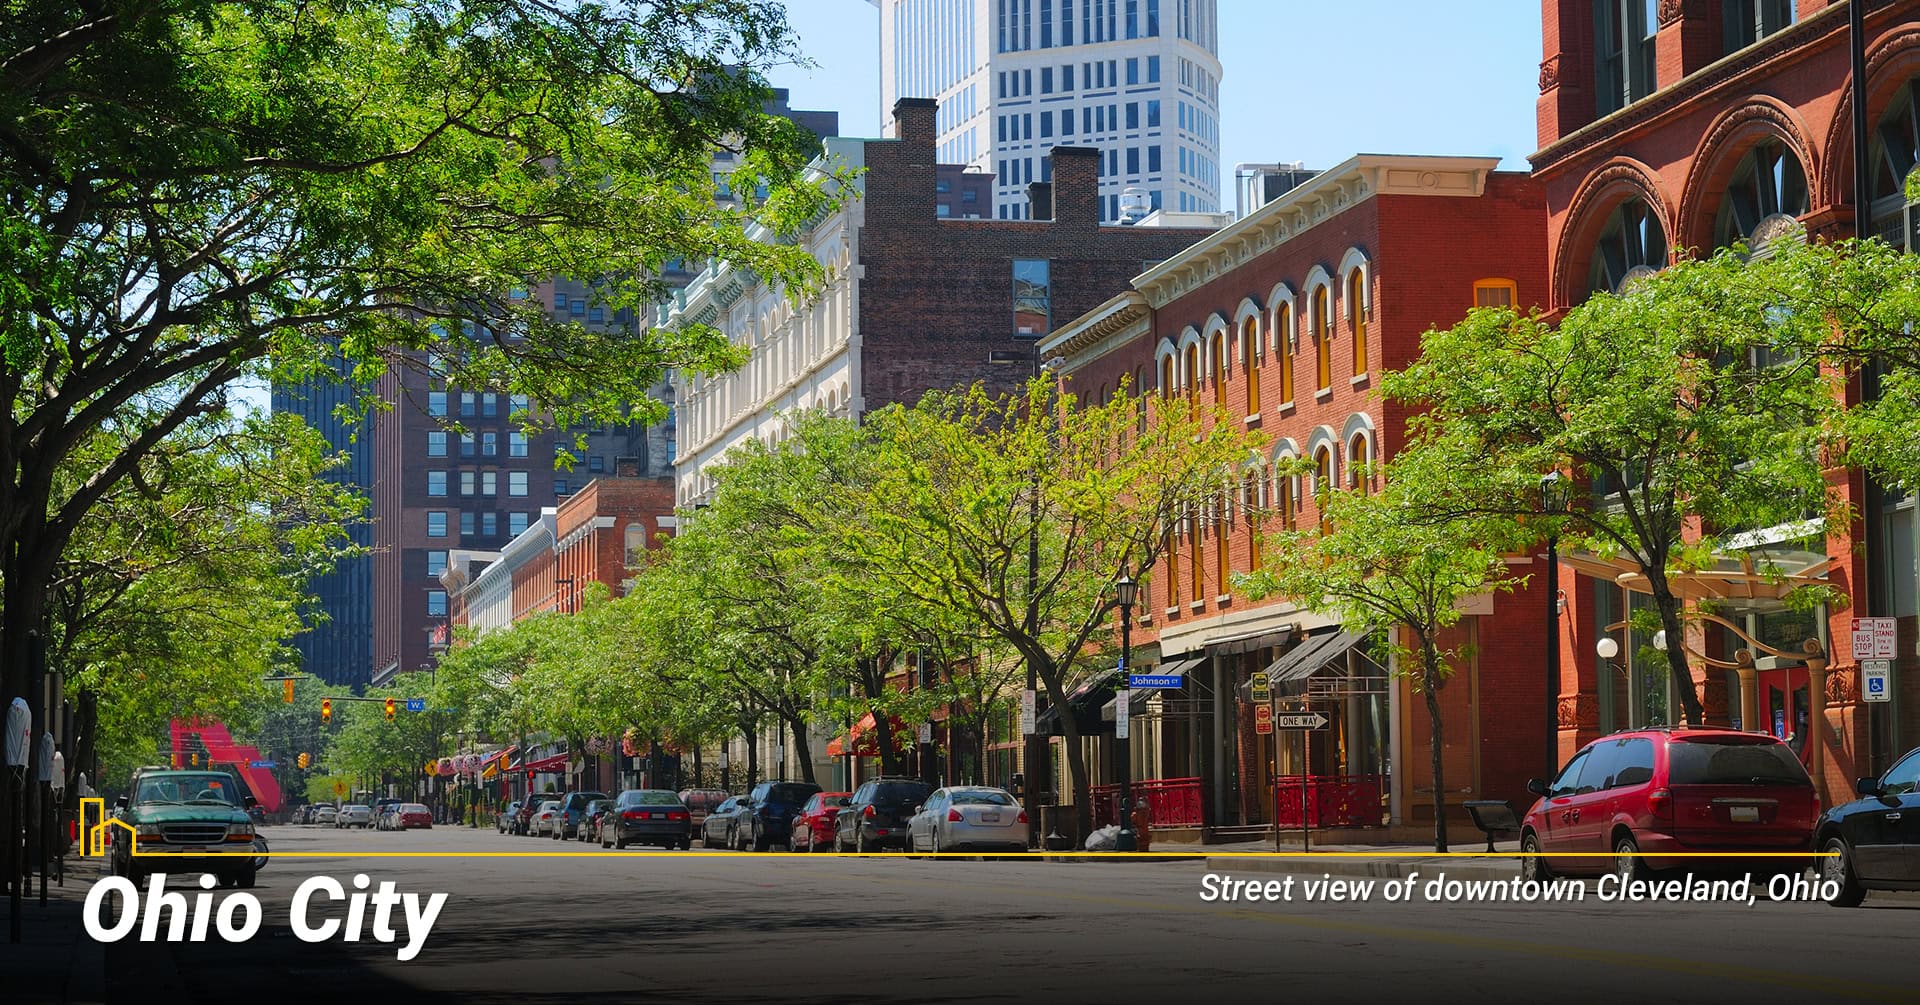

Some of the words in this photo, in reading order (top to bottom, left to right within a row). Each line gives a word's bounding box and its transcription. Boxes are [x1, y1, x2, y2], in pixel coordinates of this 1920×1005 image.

[1131, 676, 1170, 685] Johnson
[1282, 717, 1299, 726] ONE
[1302, 716, 1318, 726] WAY
